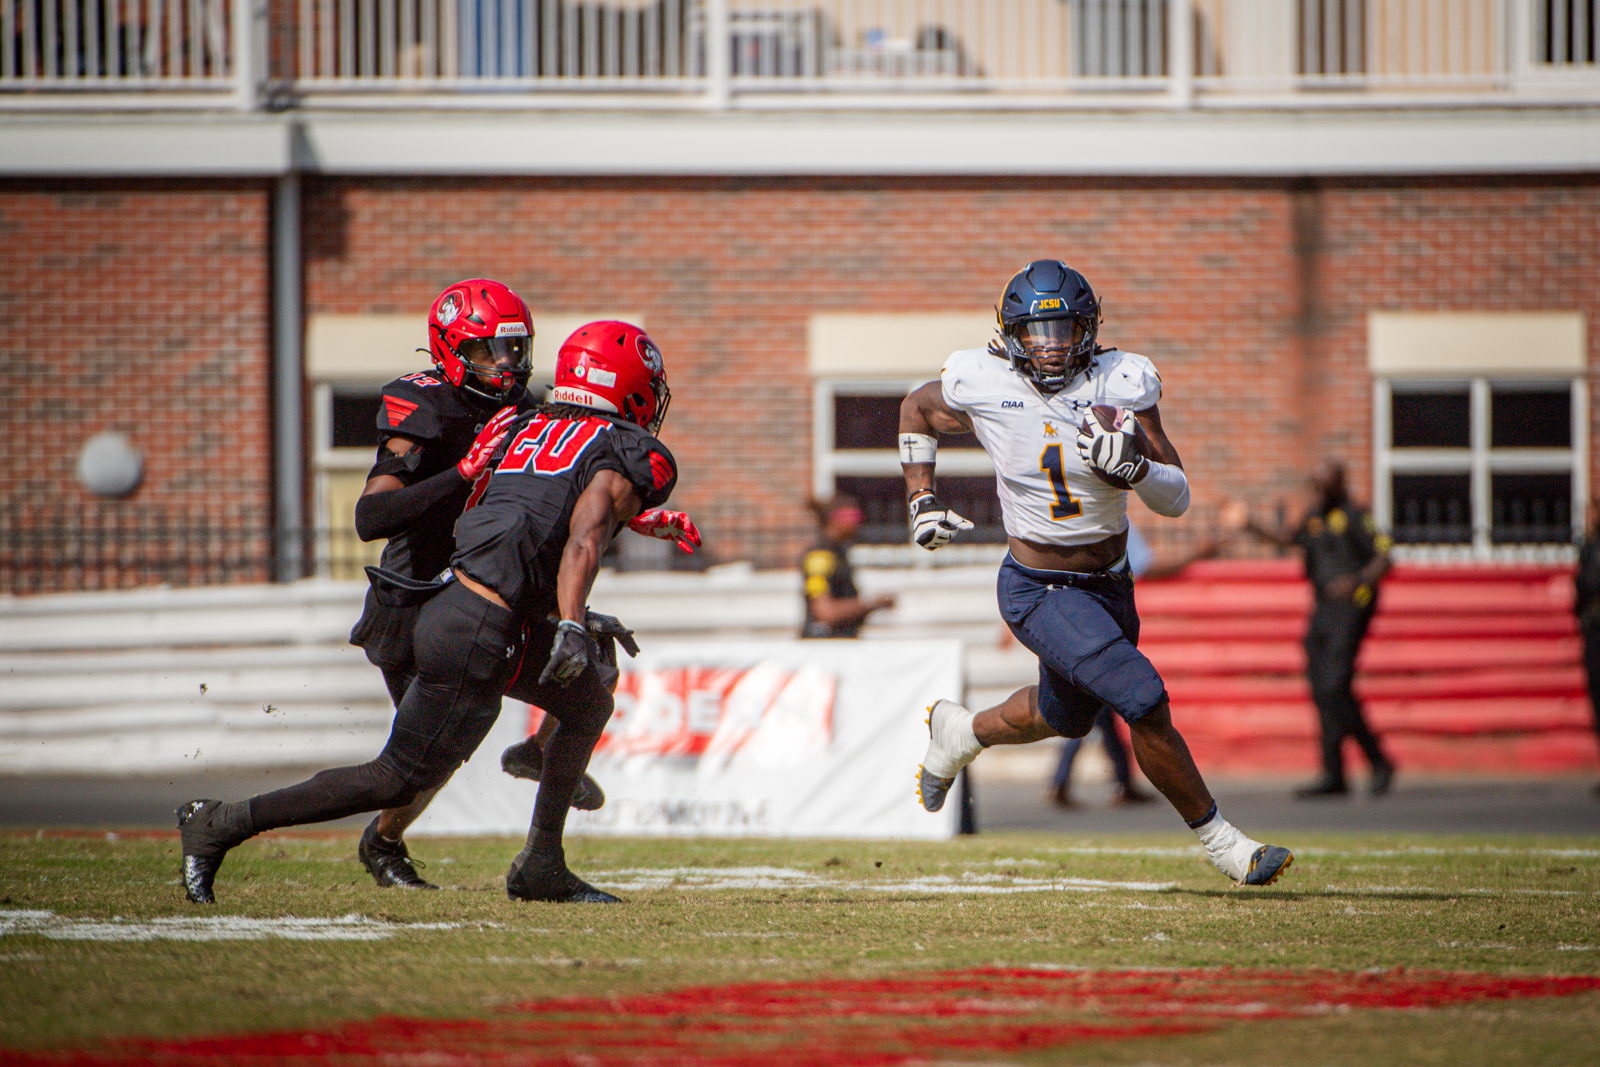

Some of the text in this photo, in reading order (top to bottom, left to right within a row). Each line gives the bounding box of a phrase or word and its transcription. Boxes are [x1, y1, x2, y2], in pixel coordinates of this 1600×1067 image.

[1039, 299, 1061, 309] JCSU
[500, 325, 526, 333] Riddell
[554, 390, 593, 406] Riddell
[1001, 401, 1024, 409] CIAA
[494, 413, 614, 476] 20
[1039, 443, 1083, 521] 1
